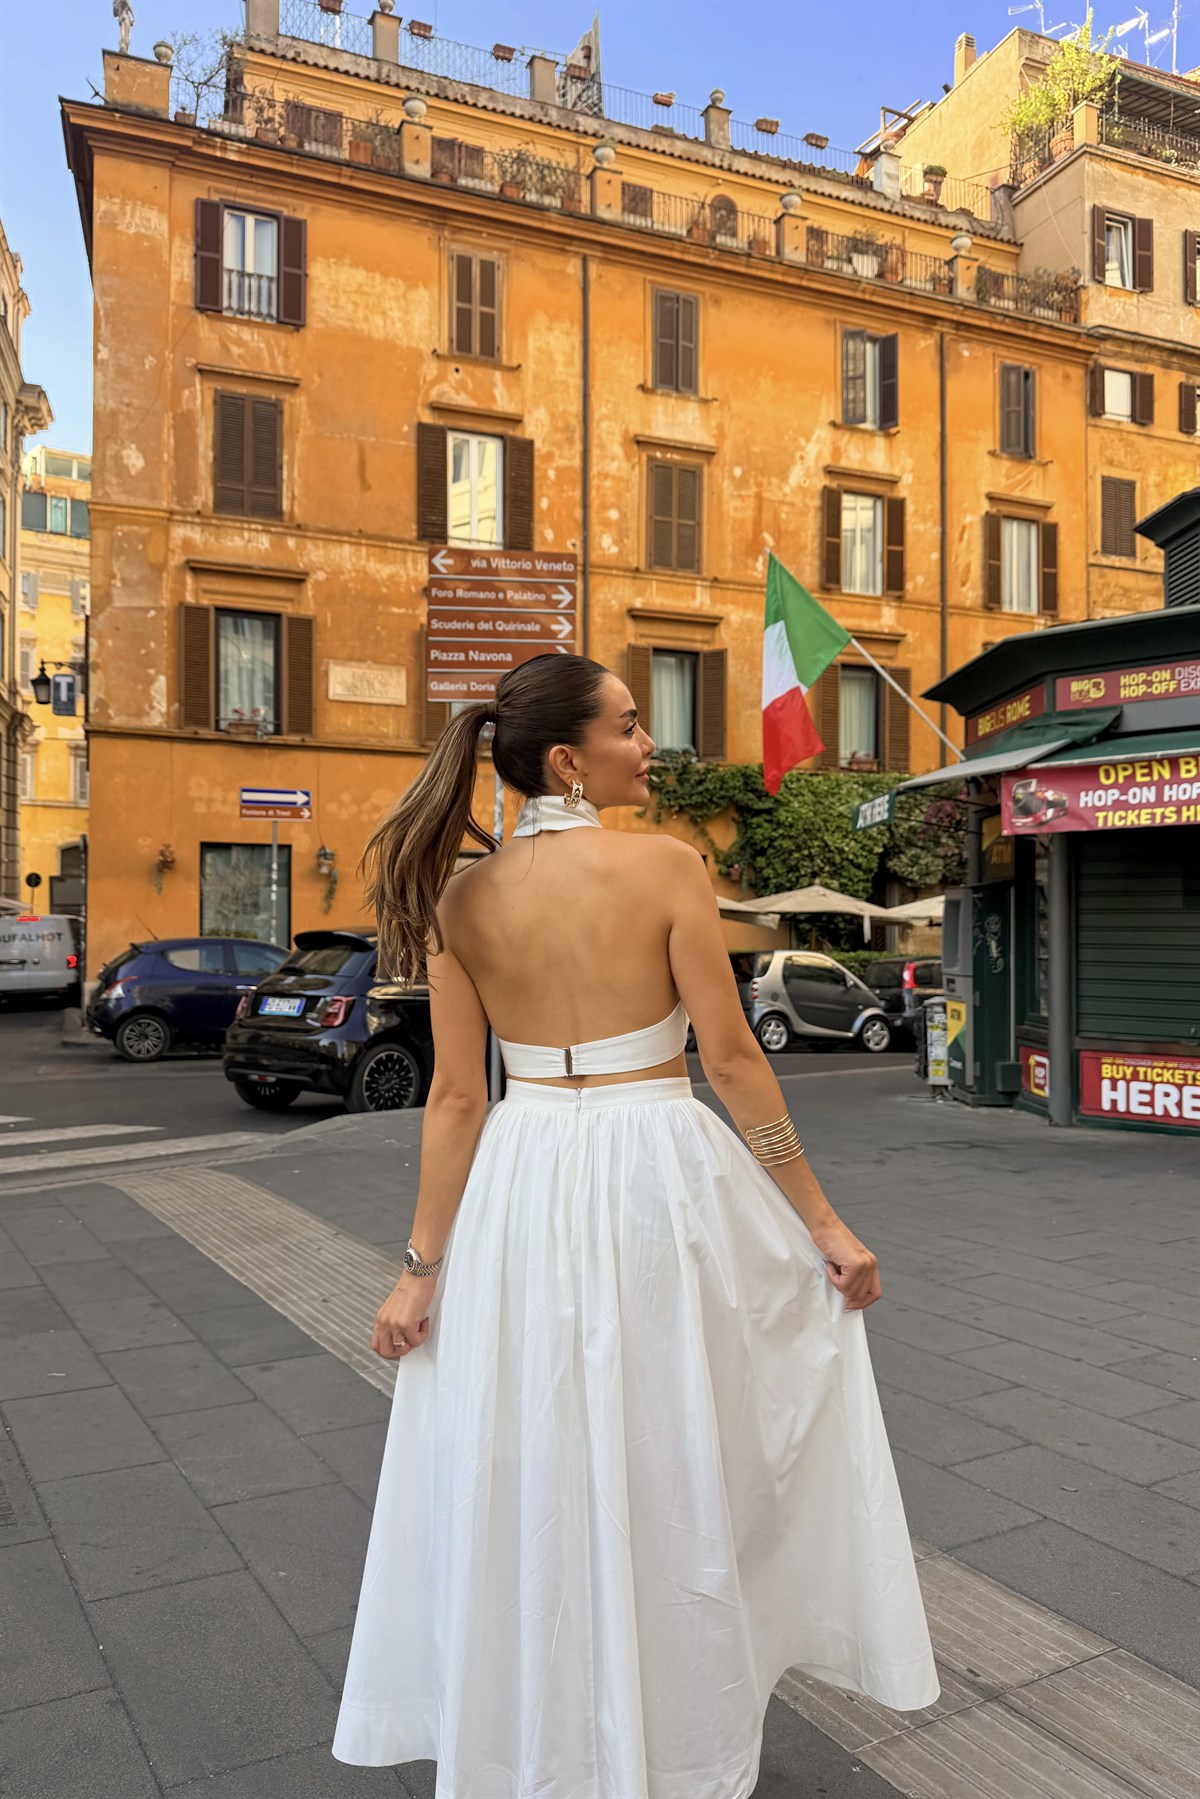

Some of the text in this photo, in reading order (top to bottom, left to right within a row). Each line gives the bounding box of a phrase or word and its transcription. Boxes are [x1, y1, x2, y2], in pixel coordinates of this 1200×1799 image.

[471, 557, 574, 572] via Vittorio Veneto
[431, 588, 547, 602] Foro Romano e Palatino
[430, 619, 541, 632] Scuderie del Quirinale
[430, 649, 513, 662] Piazza Navona
[430, 681, 496, 692] Galleria Doria
[1120, 669, 1171, 687] HOP-ON
[1120, 680, 1178, 699] HOP-OFF
[1006, 694, 1031, 724] ROME
[1099, 756, 1200, 786] OPEN B
[1079, 785, 1157, 808] HOP-ON
[1095, 806, 1177, 828] TICKETS
[1101, 1063, 1134, 1080] BUY
[1101, 1078, 1200, 1120] HERE
